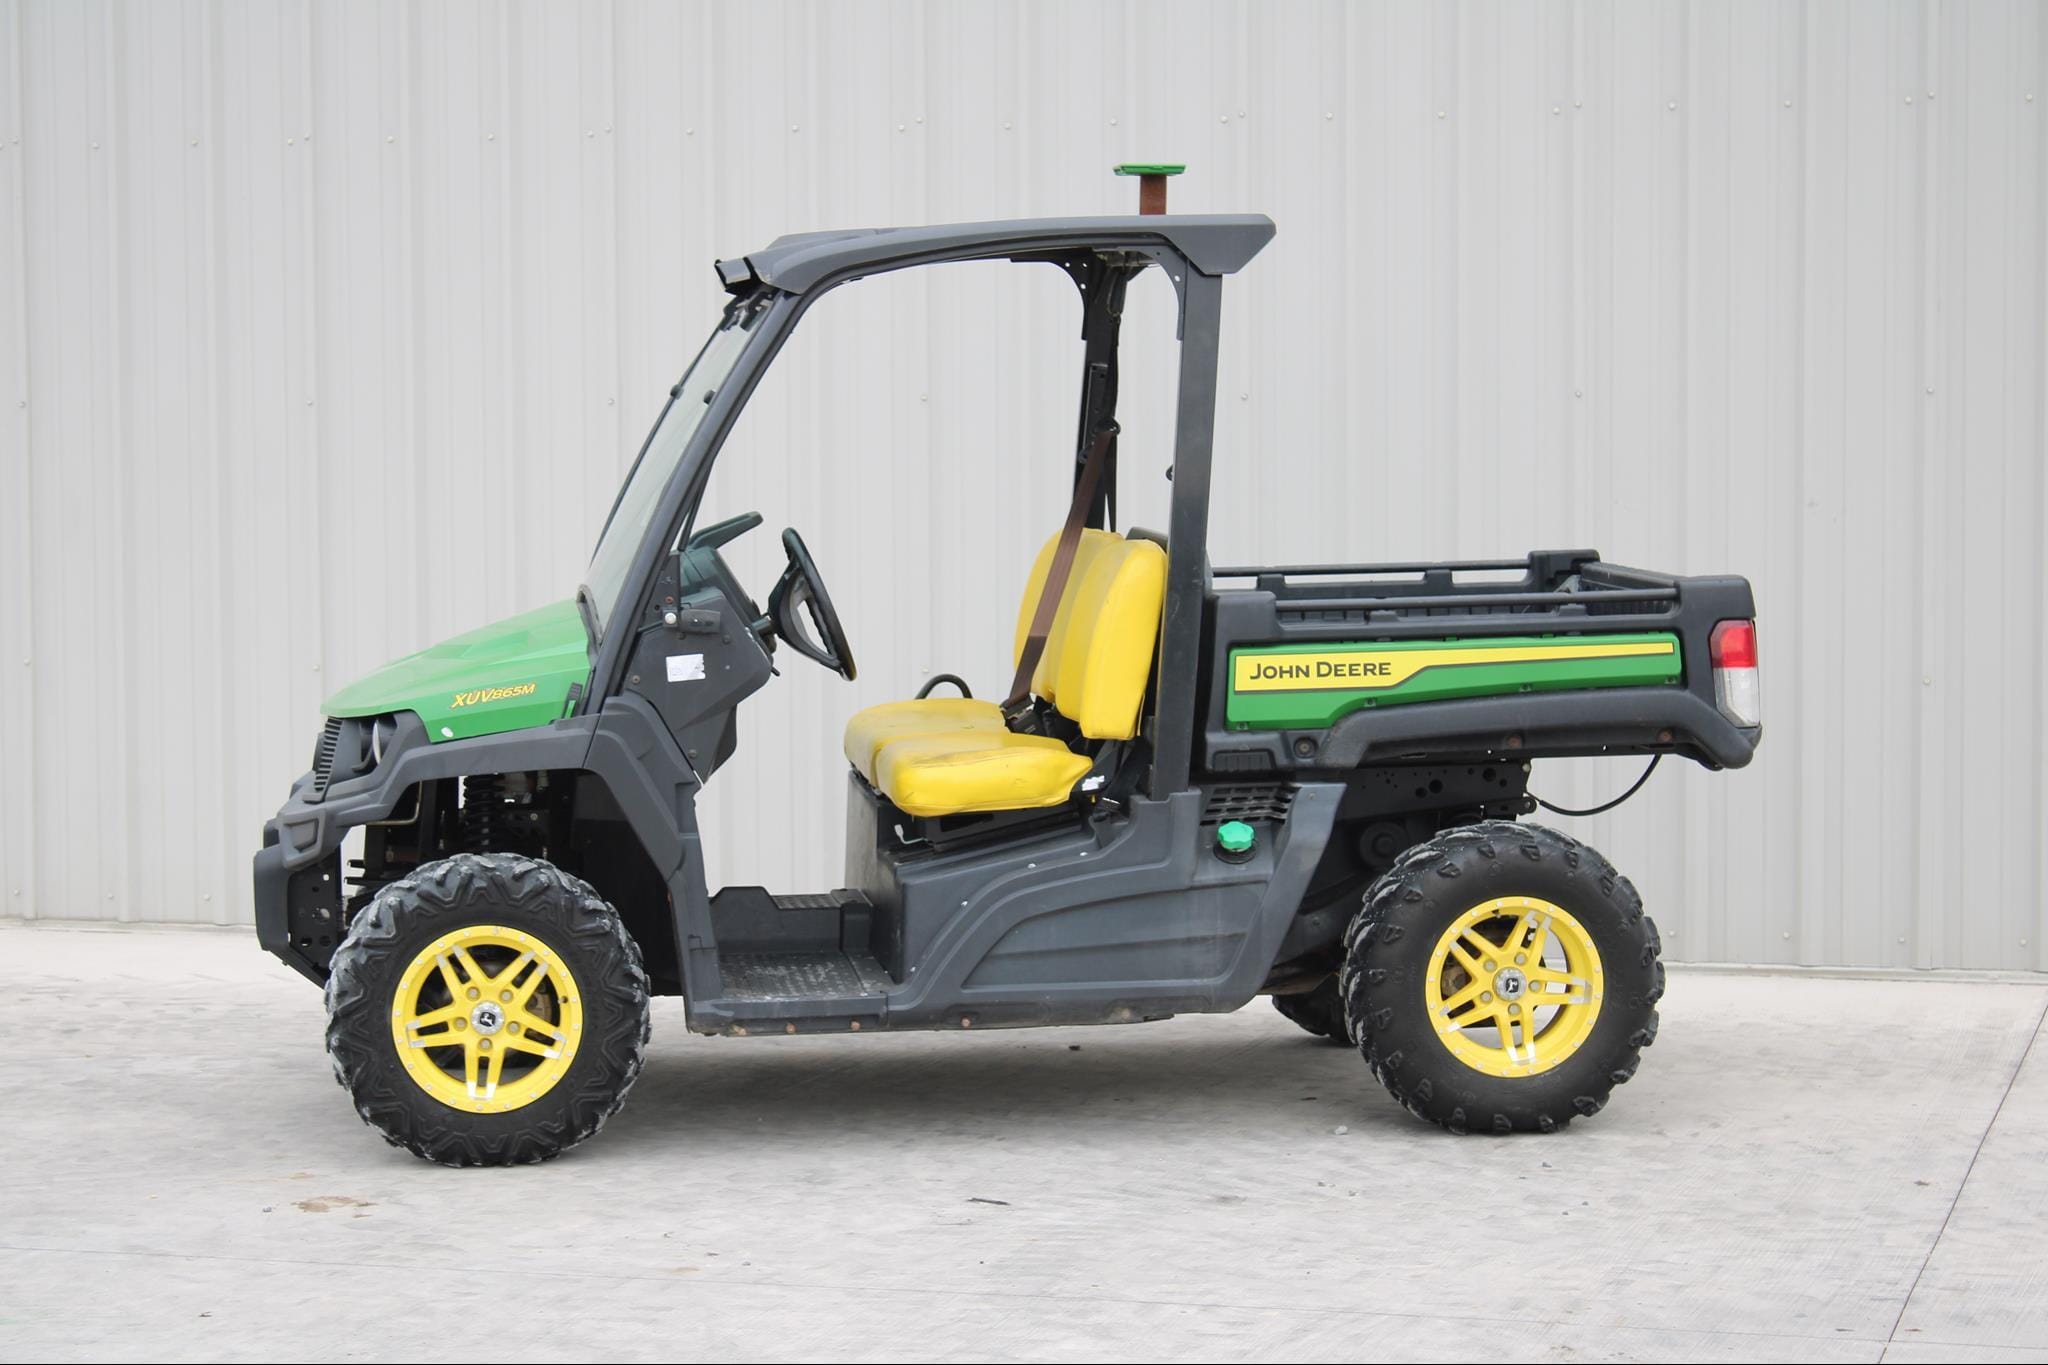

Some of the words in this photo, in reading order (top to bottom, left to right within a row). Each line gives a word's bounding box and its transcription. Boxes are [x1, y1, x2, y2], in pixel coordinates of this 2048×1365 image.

[1250, 662, 1310, 680] JOHN
[1316, 661, 1391, 678] DEERE
[450, 682, 536, 709] XUV865M
